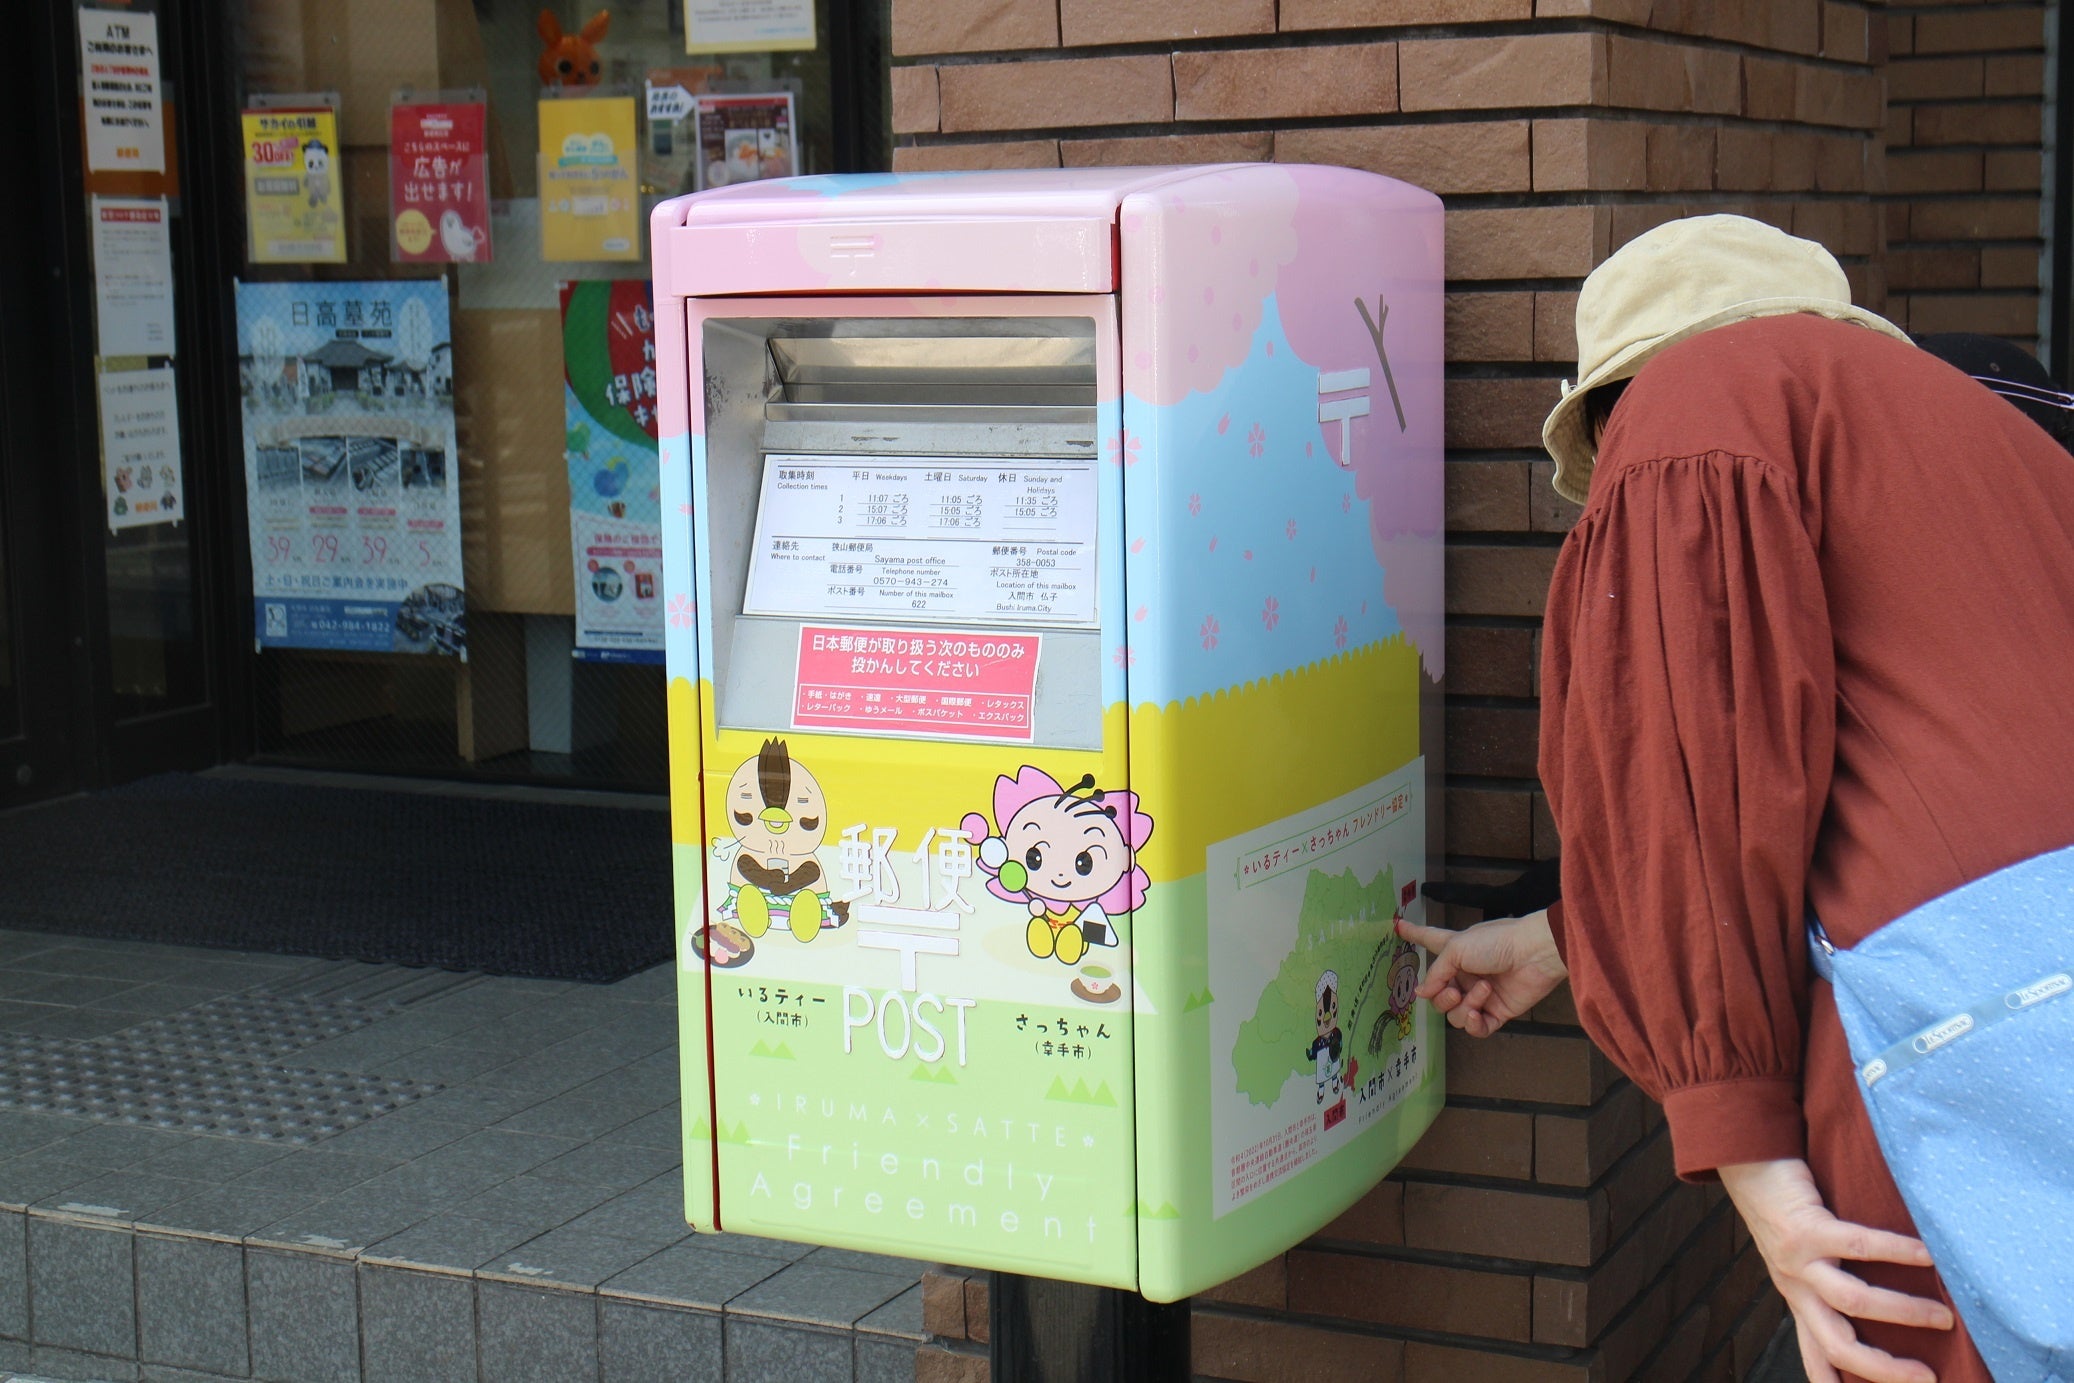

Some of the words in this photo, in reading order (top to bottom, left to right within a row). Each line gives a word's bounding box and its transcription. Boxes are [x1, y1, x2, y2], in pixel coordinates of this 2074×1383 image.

[106, 26, 130, 38] ATM
[253, 142, 273, 163] 30
[414, 157, 462, 178] 広告が
[405, 182, 472, 202] 出せます!
[292, 300, 393, 327] 日高墓苑
[779, 470, 815, 480] 取集時刻
[852, 472, 869, 480] 平日
[924, 472, 951, 482] 土曜日
[959, 475, 988, 483] Saturday
[999, 473, 1016, 482] 休日
[892, 494, 909, 503] ごろ
[941, 495, 961, 504] 11:05
[966, 495, 982, 504] ごろ
[1041, 496, 1058, 505] ごろ
[868, 505, 887, 513] 15:07
[891, 505, 908, 514] ごろ
[965, 506, 982, 515] ごろ
[1015, 508, 1036, 516] 15:05
[1041, 508, 1057, 517] ごろ
[891, 516, 907, 525] ごろ
[939, 518, 959, 526] 17:06
[964, 517, 981, 526] ごろ
[267, 536, 290, 563] 39
[312, 535, 338, 563] 29
[362, 536, 387, 564] 39
[772, 541, 799, 550] 連絡先
[832, 542, 873, 552] 狭山郵便局
[992, 547, 1027, 555] 郵便番号
[875, 555, 904, 564] Sayama
[907, 556, 922, 564] post
[925, 556, 946, 564] office
[1016, 559, 1055, 567] 358-0053
[830, 564, 863, 574] 電話番号
[882, 567, 914, 576] Telephone
[990, 569, 1038, 578] ポスト所在地
[873, 577, 948, 586] 0570-943-274
[1051, 582, 1076, 590] mailbox
[828, 587, 864, 596] ポスト番号
[1008, 592, 1033, 600] 入間市
[1041, 593, 1057, 601] 仏子
[912, 600, 926, 608] 622
[813, 635, 1024, 659] 日本郵便が取り扱う次のもののみ
[852, 658, 979, 678] 投かんしてください
[896, 694, 926, 705] 大型郵便
[838, 824, 975, 913] 郵便
[739, 986, 826, 1007] いるティー
[756, 1010, 809, 1029] (入間市)
[842, 986, 977, 1067] POST
[1015, 1014, 1112, 1041] さっちゃん
[1035, 1040, 1092, 1060] (幸手市)
[786, 1135, 1054, 1200] Friendly
[750, 1172, 1099, 1243] Agreement
